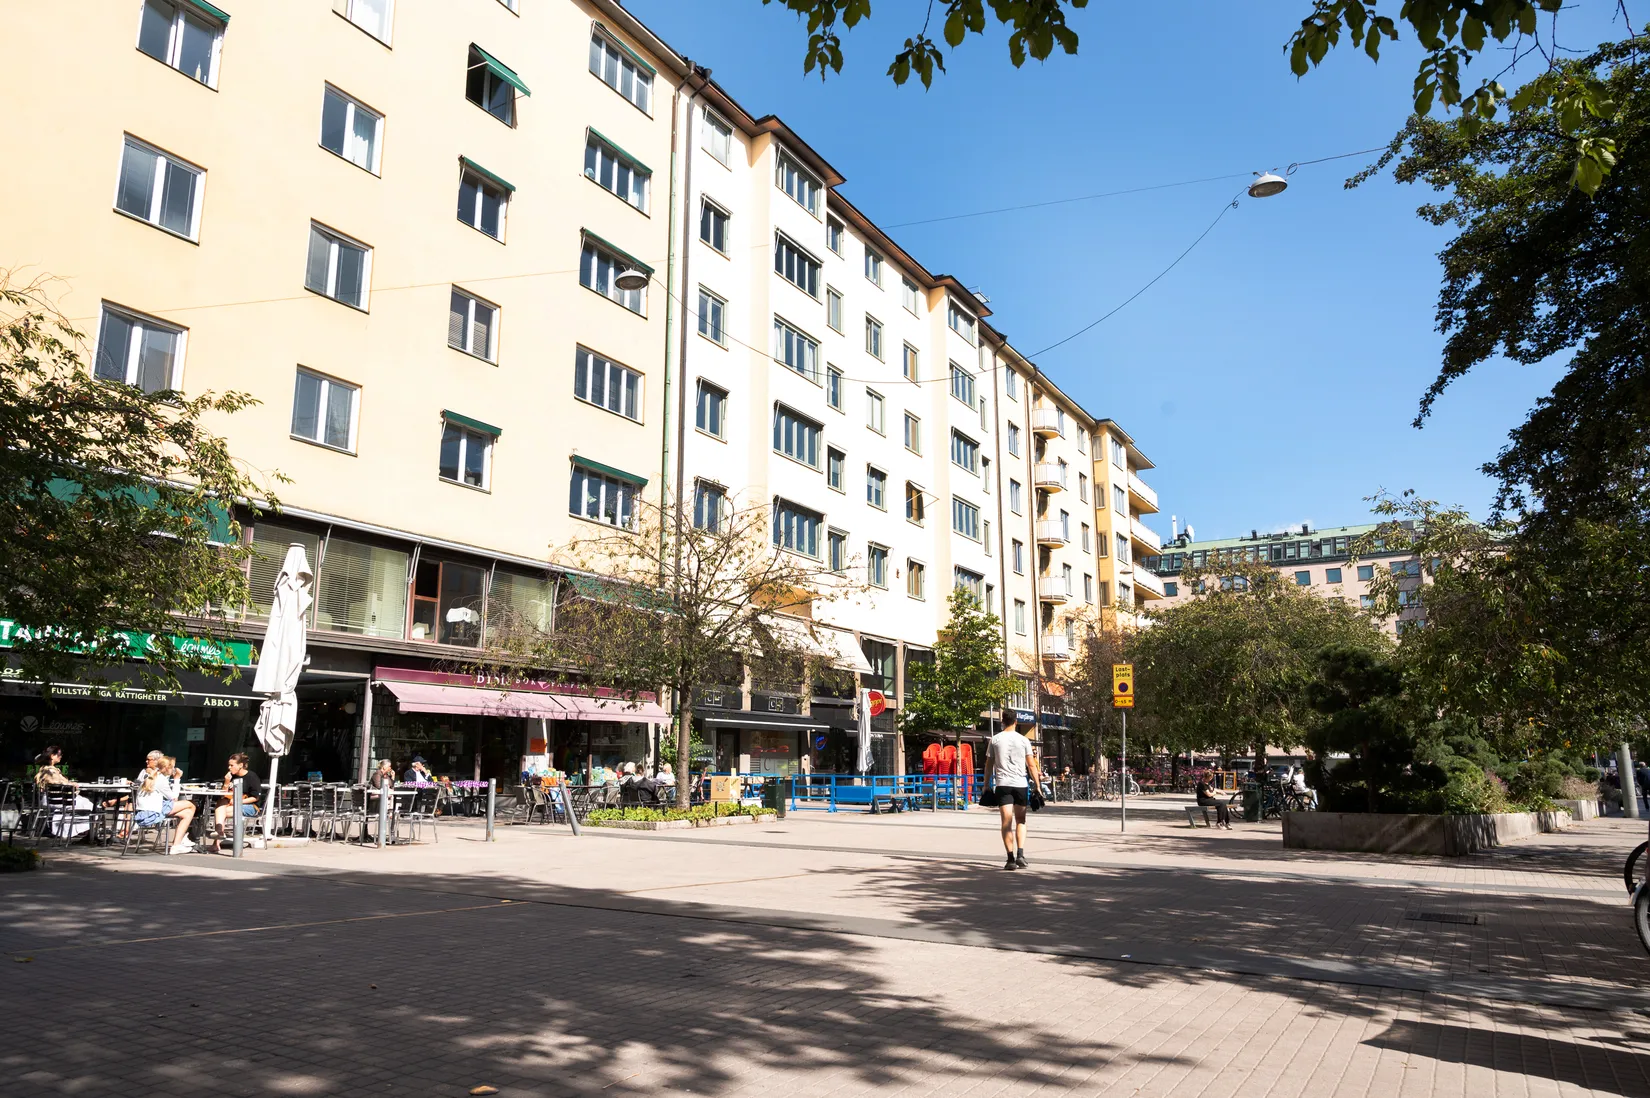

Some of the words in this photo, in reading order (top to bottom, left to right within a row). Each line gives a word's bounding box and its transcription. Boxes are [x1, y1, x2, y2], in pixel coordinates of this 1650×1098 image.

[51, 687, 112, 698] FULLSTÄIGA
[115, 690, 167, 701] RÄTTIGHETER
[203, 697, 232, 707] ÅBRO
